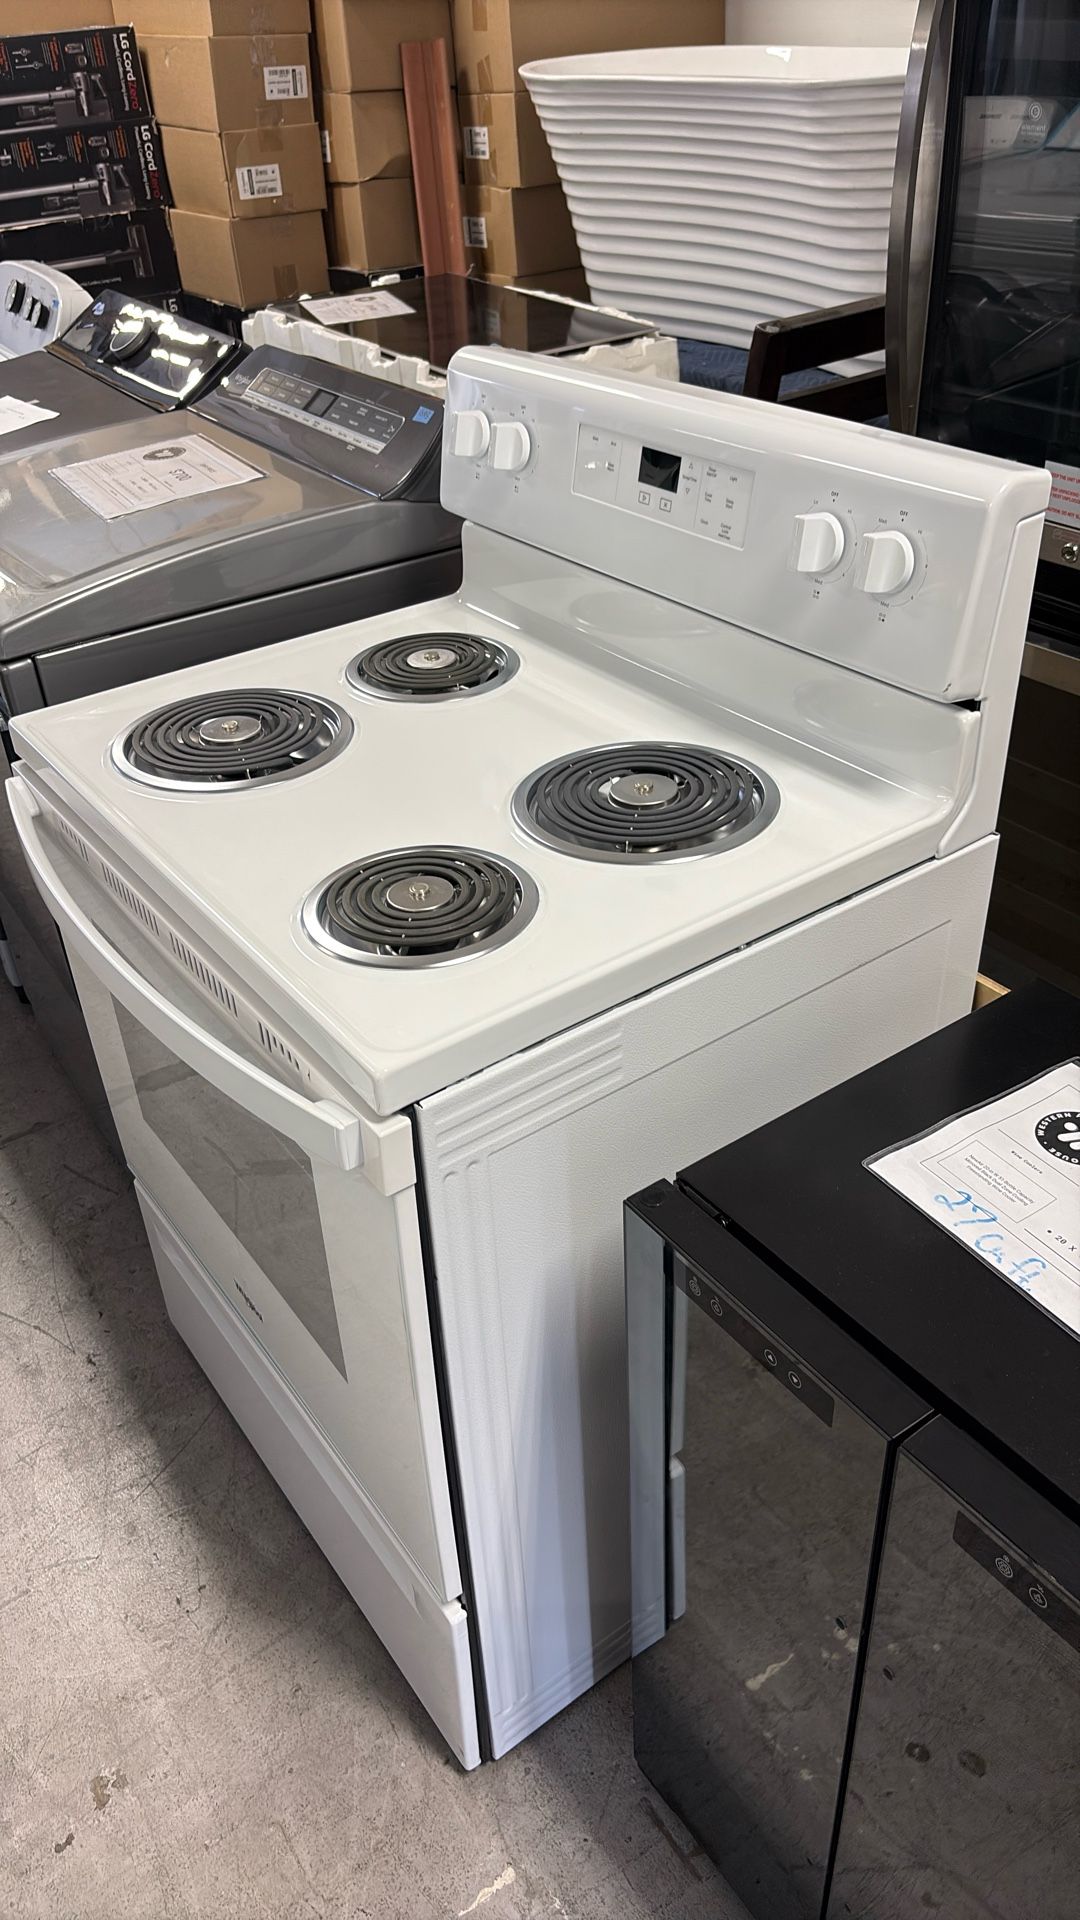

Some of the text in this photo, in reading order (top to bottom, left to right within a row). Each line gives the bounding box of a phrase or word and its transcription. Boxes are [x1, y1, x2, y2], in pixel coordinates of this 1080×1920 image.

[119, 33, 130, 49] LG
[141, 125, 151, 140] LG
[168, 299, 178, 313] LG
[1037, 1112, 1072, 1136] WESTERN
[934, 1190, 998, 1227] 27
[1054, 1235, 1067, 1245] 20
